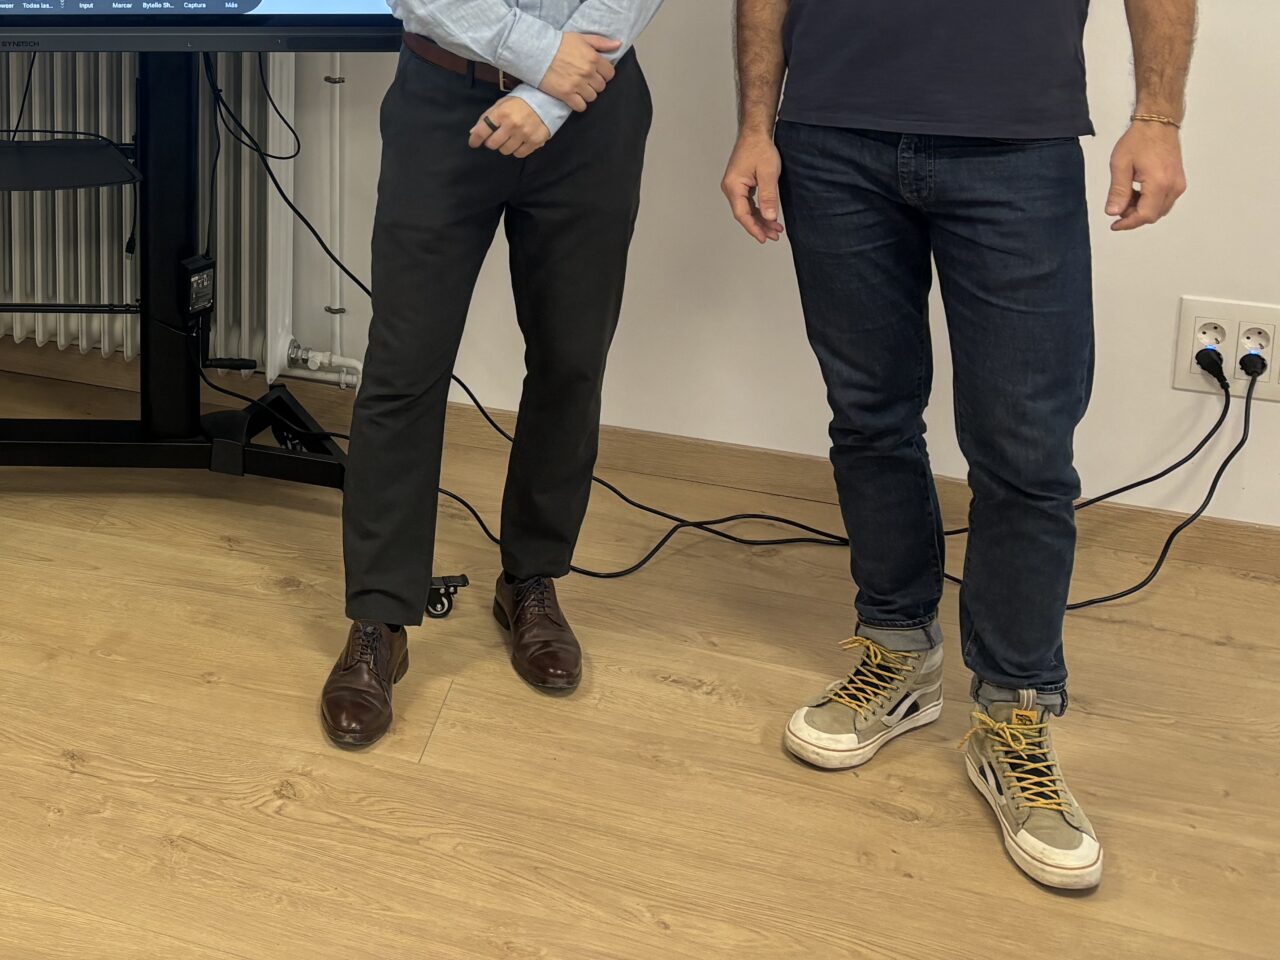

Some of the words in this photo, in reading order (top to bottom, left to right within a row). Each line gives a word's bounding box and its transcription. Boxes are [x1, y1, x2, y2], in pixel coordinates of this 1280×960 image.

[79, 2, 94, 10] Input
[183, 1, 206, 10] Captura
[225, 1, 239, 9] Más
